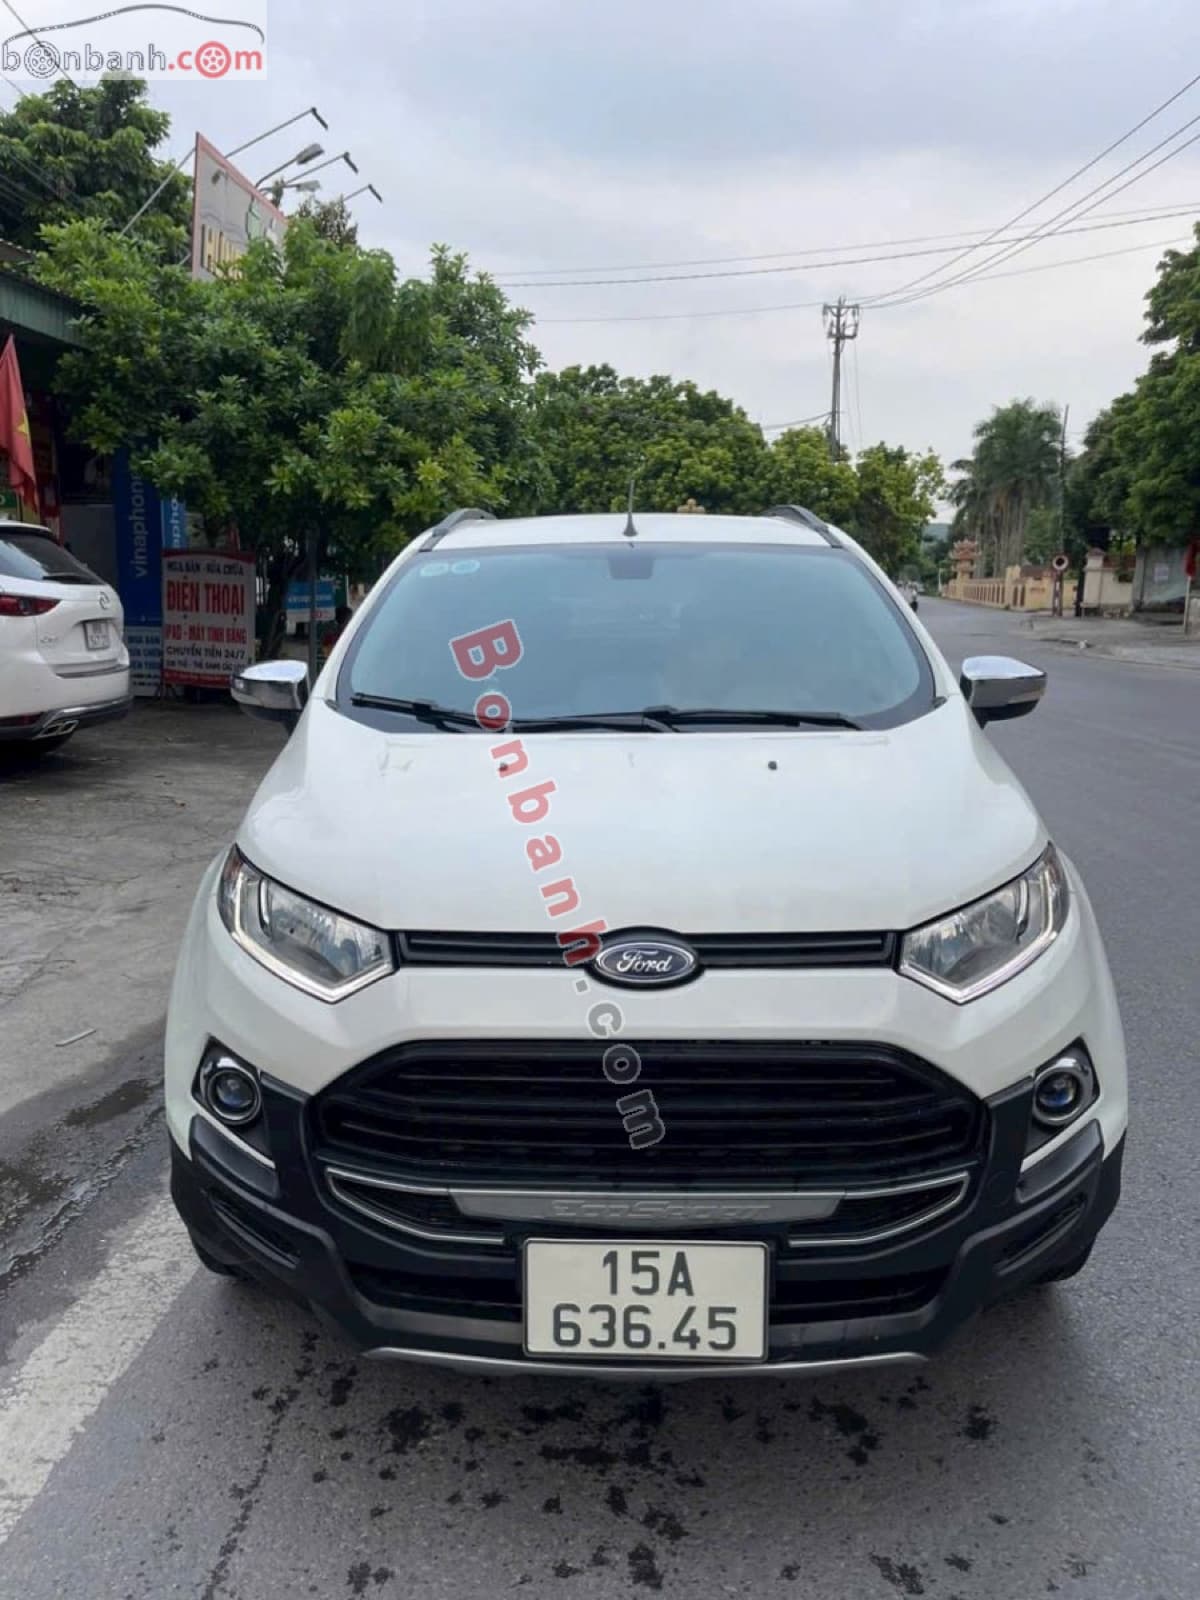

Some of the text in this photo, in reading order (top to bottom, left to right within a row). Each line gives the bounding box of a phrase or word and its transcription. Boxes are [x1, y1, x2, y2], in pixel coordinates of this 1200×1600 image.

[167, 575, 245, 622] ĐIỆN THOẠI
[224, 648, 246, 660] 24/7
[616, 949, 674, 973] Ford
[602, 1250, 695, 1297] 15A
[552, 1303, 738, 1351] 636.45
